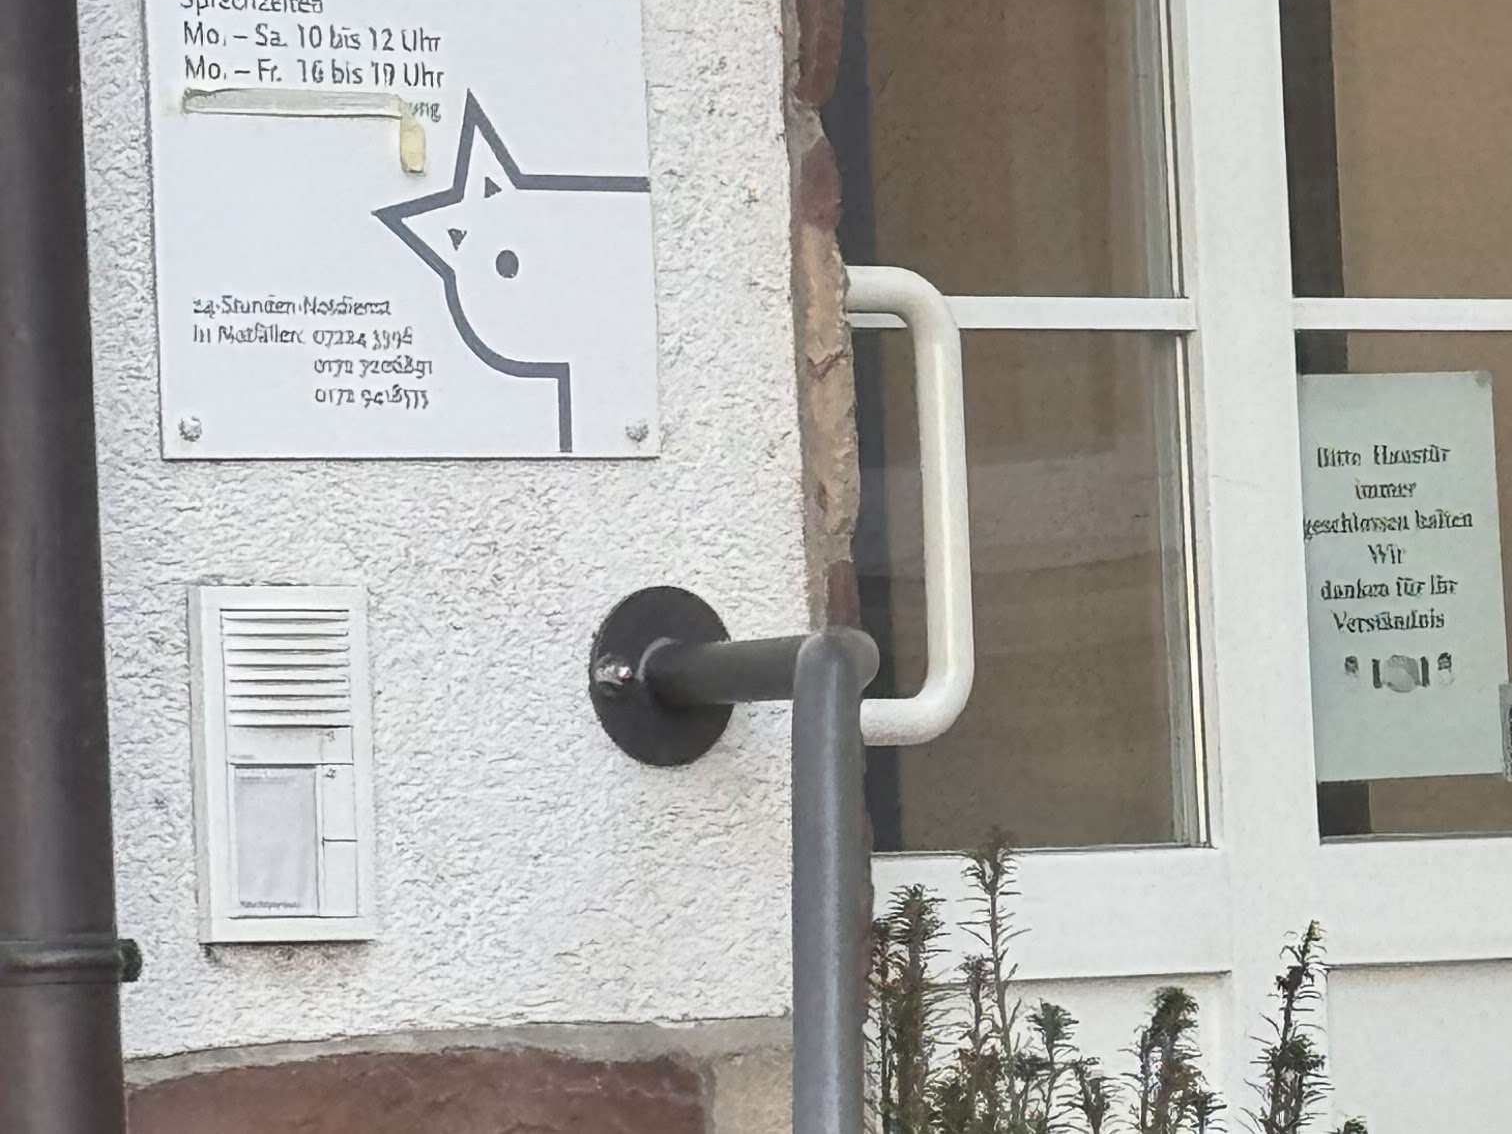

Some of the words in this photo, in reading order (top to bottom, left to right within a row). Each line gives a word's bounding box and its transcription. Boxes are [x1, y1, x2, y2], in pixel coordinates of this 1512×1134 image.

[183, 20, 227, 47] Mo.
[298, 24, 322, 49] 10
[329, 25, 361, 51] bis
[369, 26, 395, 52] 12
[401, 27, 442, 53] Uhr
[184, 54, 228, 81] Mo.
[257, 58, 282, 83] Fr.
[331, 59, 363, 85] bis
[403, 60, 445, 88] Uhr
[315, 387, 355, 406] 0172
[1317, 447, 1361, 468] Bitte
[1374, 444, 1450, 466] Haustür
[1354, 477, 1416, 500] immer
[1303, 511, 1410, 541] geschlossen
[1415, 509, 1473, 530] halten
[1367, 542, 1404, 565] Wir
[1320, 578, 1390, 601] danken
[1397, 577, 1426, 597] für
[1332, 607, 1446, 633] Verständnis
